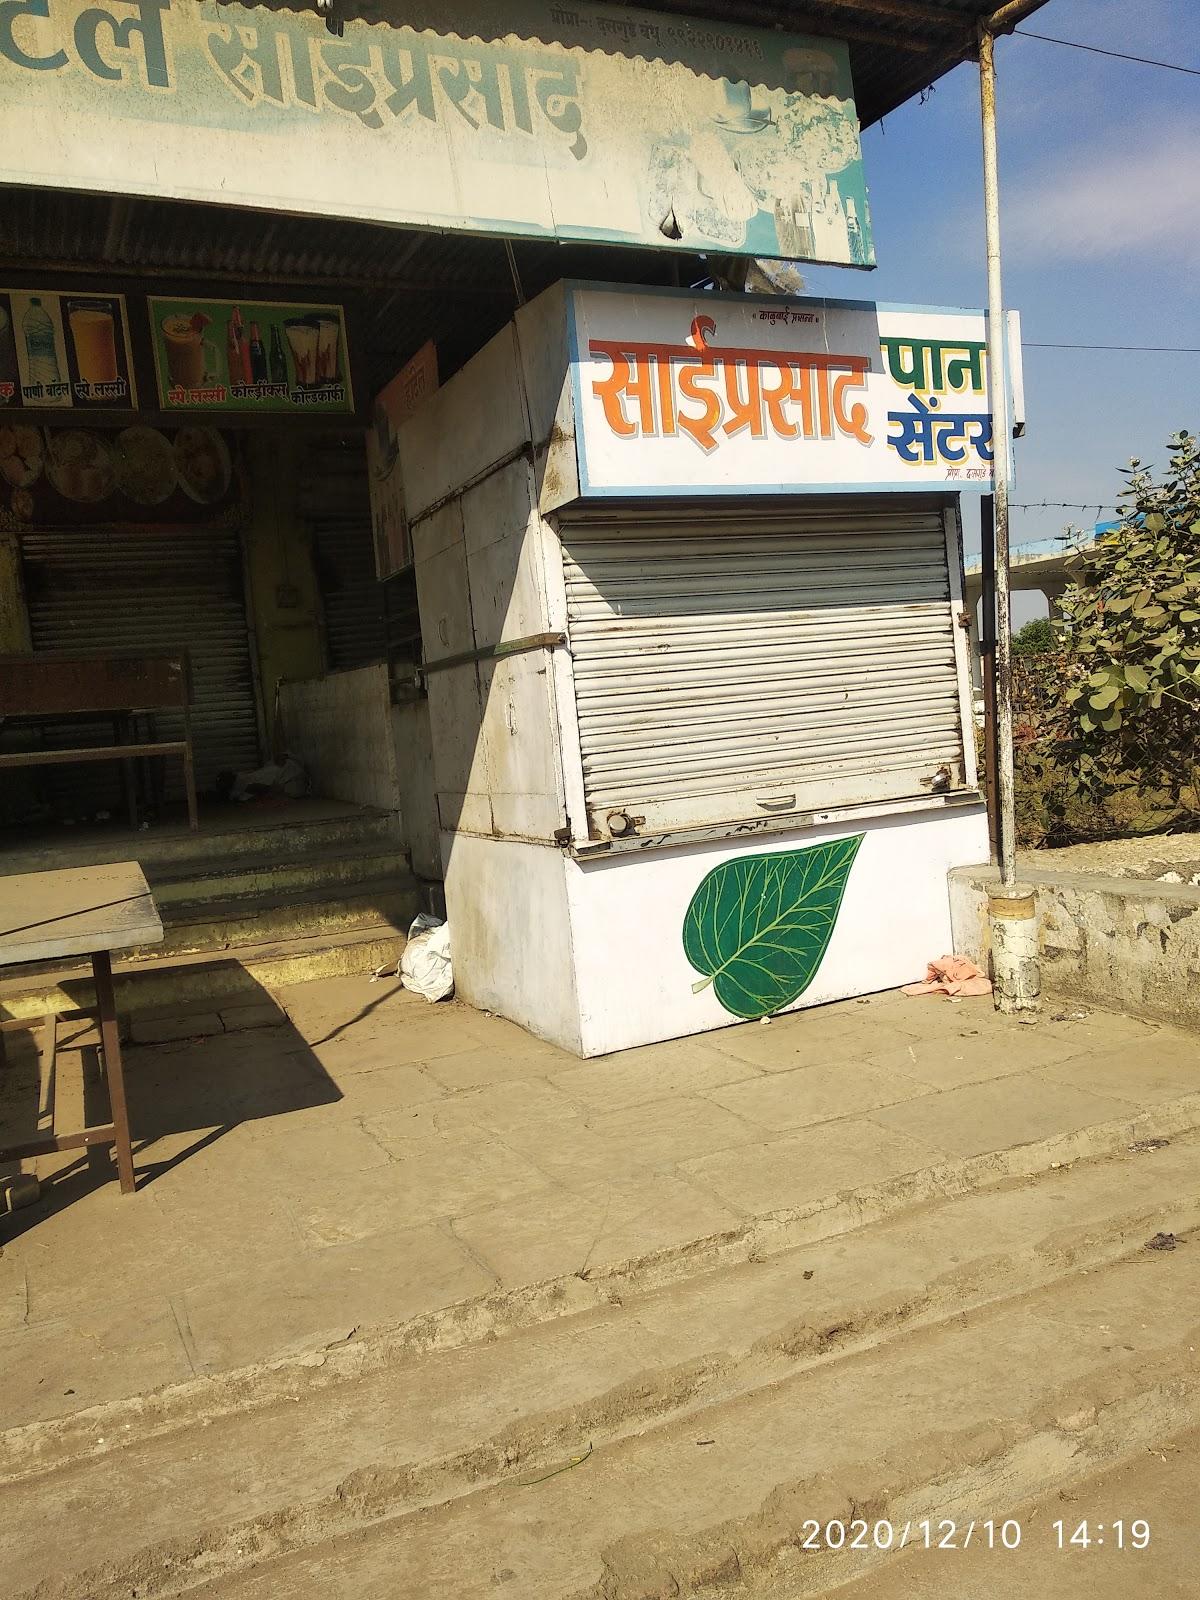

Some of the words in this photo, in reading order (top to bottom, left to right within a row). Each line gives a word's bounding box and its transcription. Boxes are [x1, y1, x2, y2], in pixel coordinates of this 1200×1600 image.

[589, 315, 872, 453] साईप्रसाद
[880, 336, 987, 392] पान
[887, 393, 994, 463] सेंटर
